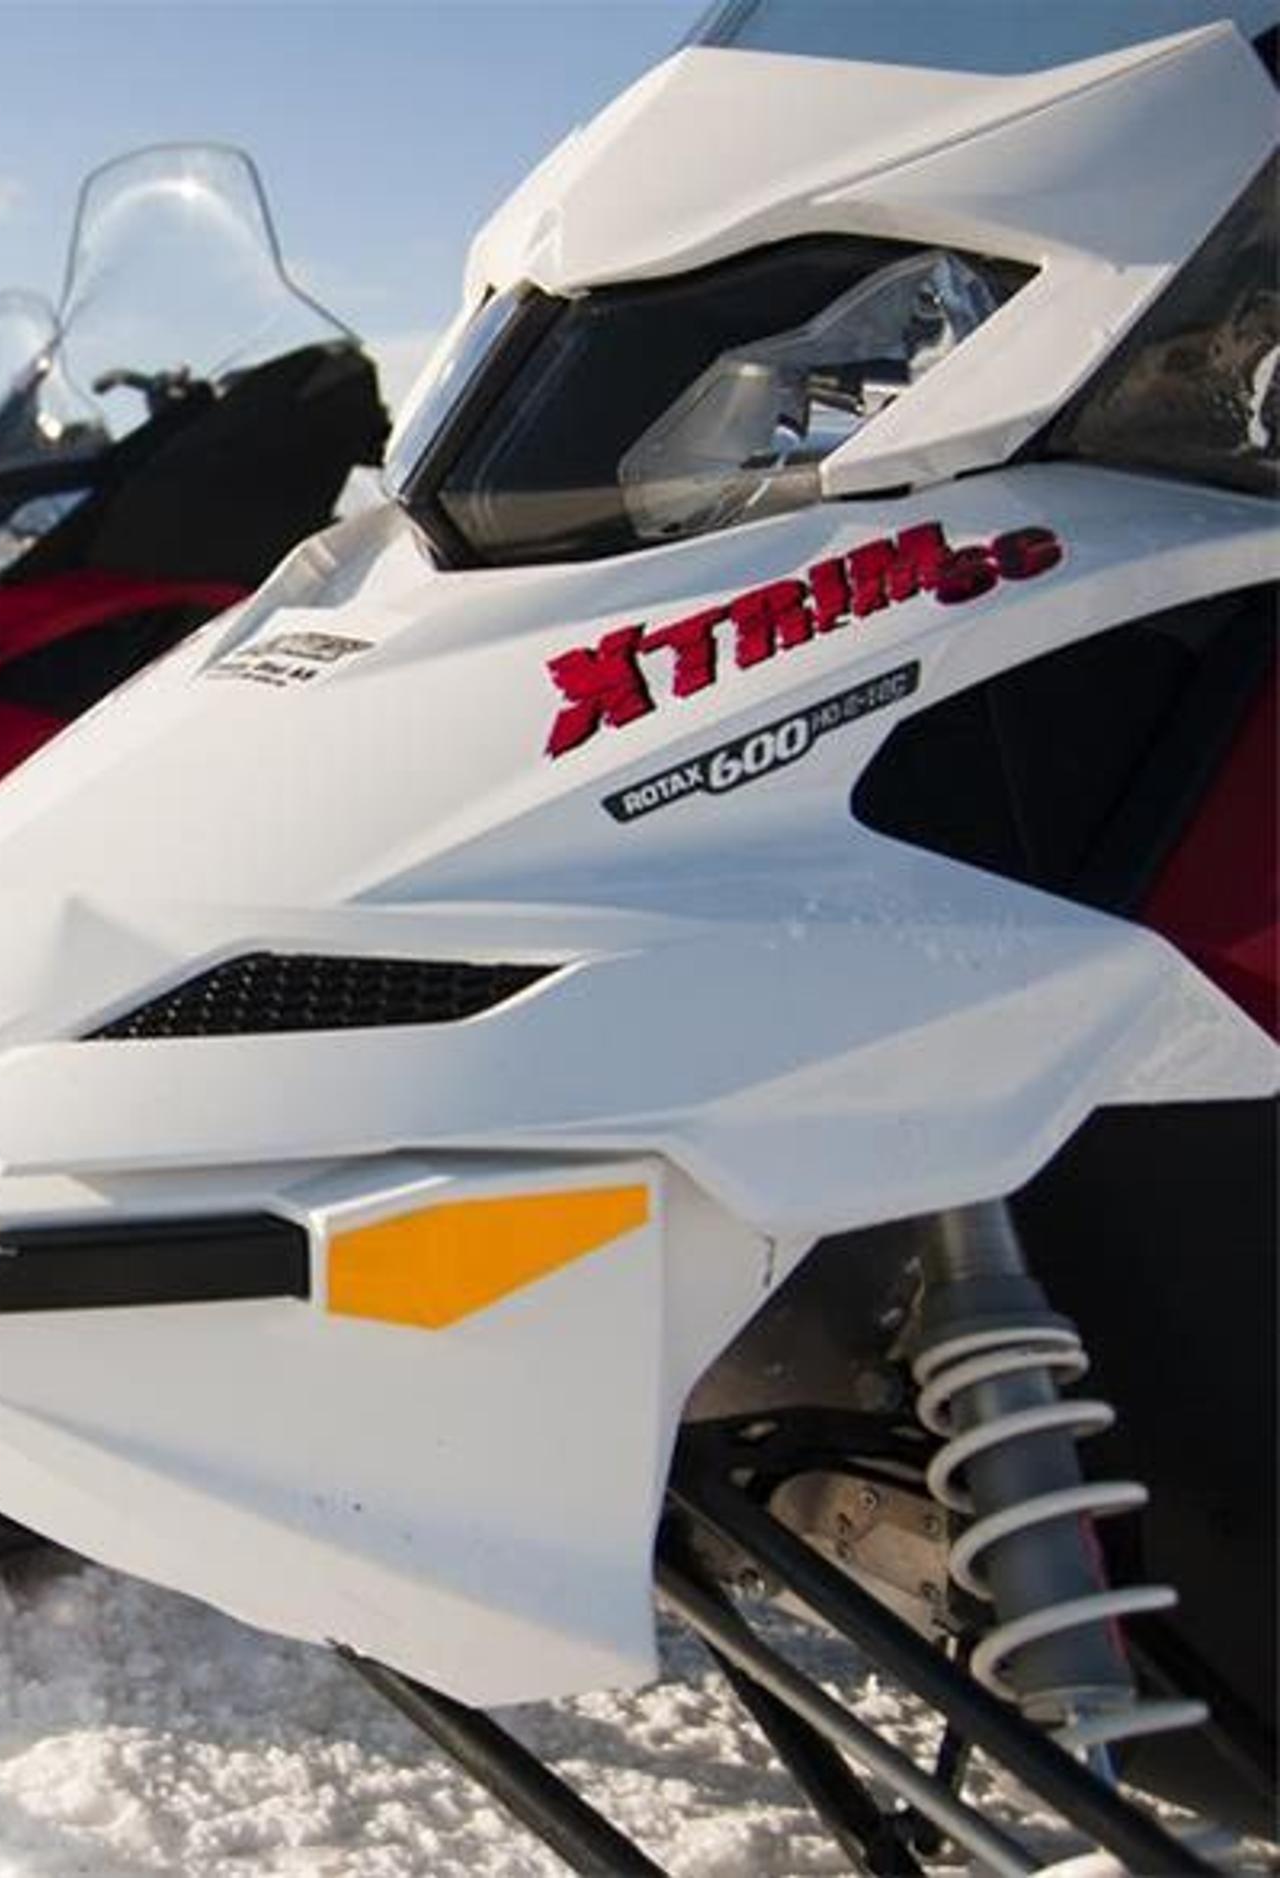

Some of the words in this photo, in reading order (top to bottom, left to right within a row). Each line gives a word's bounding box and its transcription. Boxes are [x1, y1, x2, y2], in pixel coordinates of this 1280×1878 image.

[544, 522, 945, 759] XTRIM
[622, 761, 704, 815] ROTAX
[708, 717, 809, 791] 600
